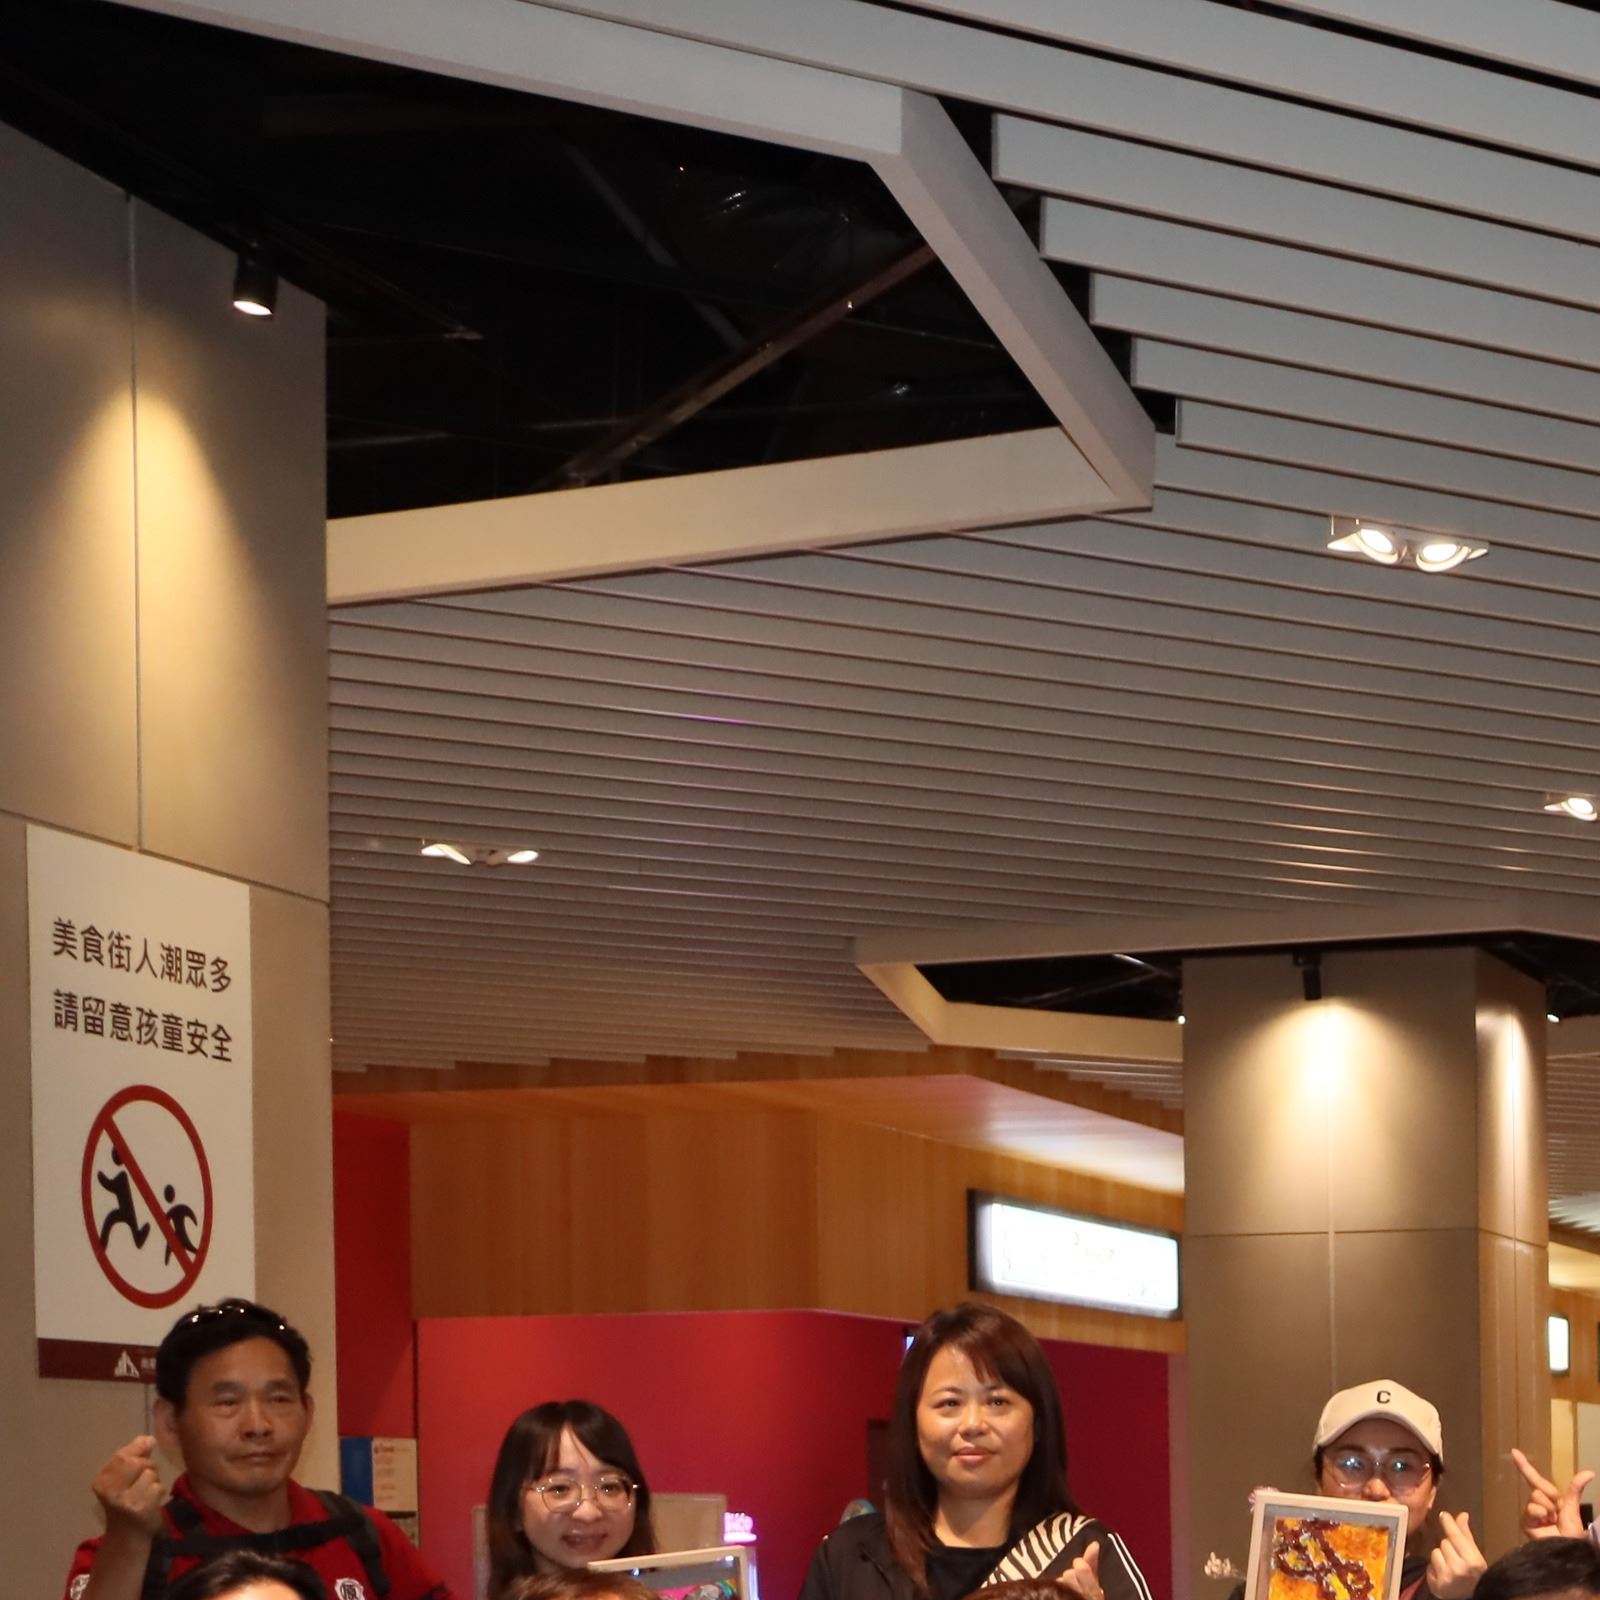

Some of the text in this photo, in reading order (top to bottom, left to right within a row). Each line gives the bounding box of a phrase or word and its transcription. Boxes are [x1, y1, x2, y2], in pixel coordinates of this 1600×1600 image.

[53, 917, 232, 993] 美食街人潮眾多
[53, 988, 232, 1063] 請留意孩童安全
[1377, 1390, 1391, 1404] C
